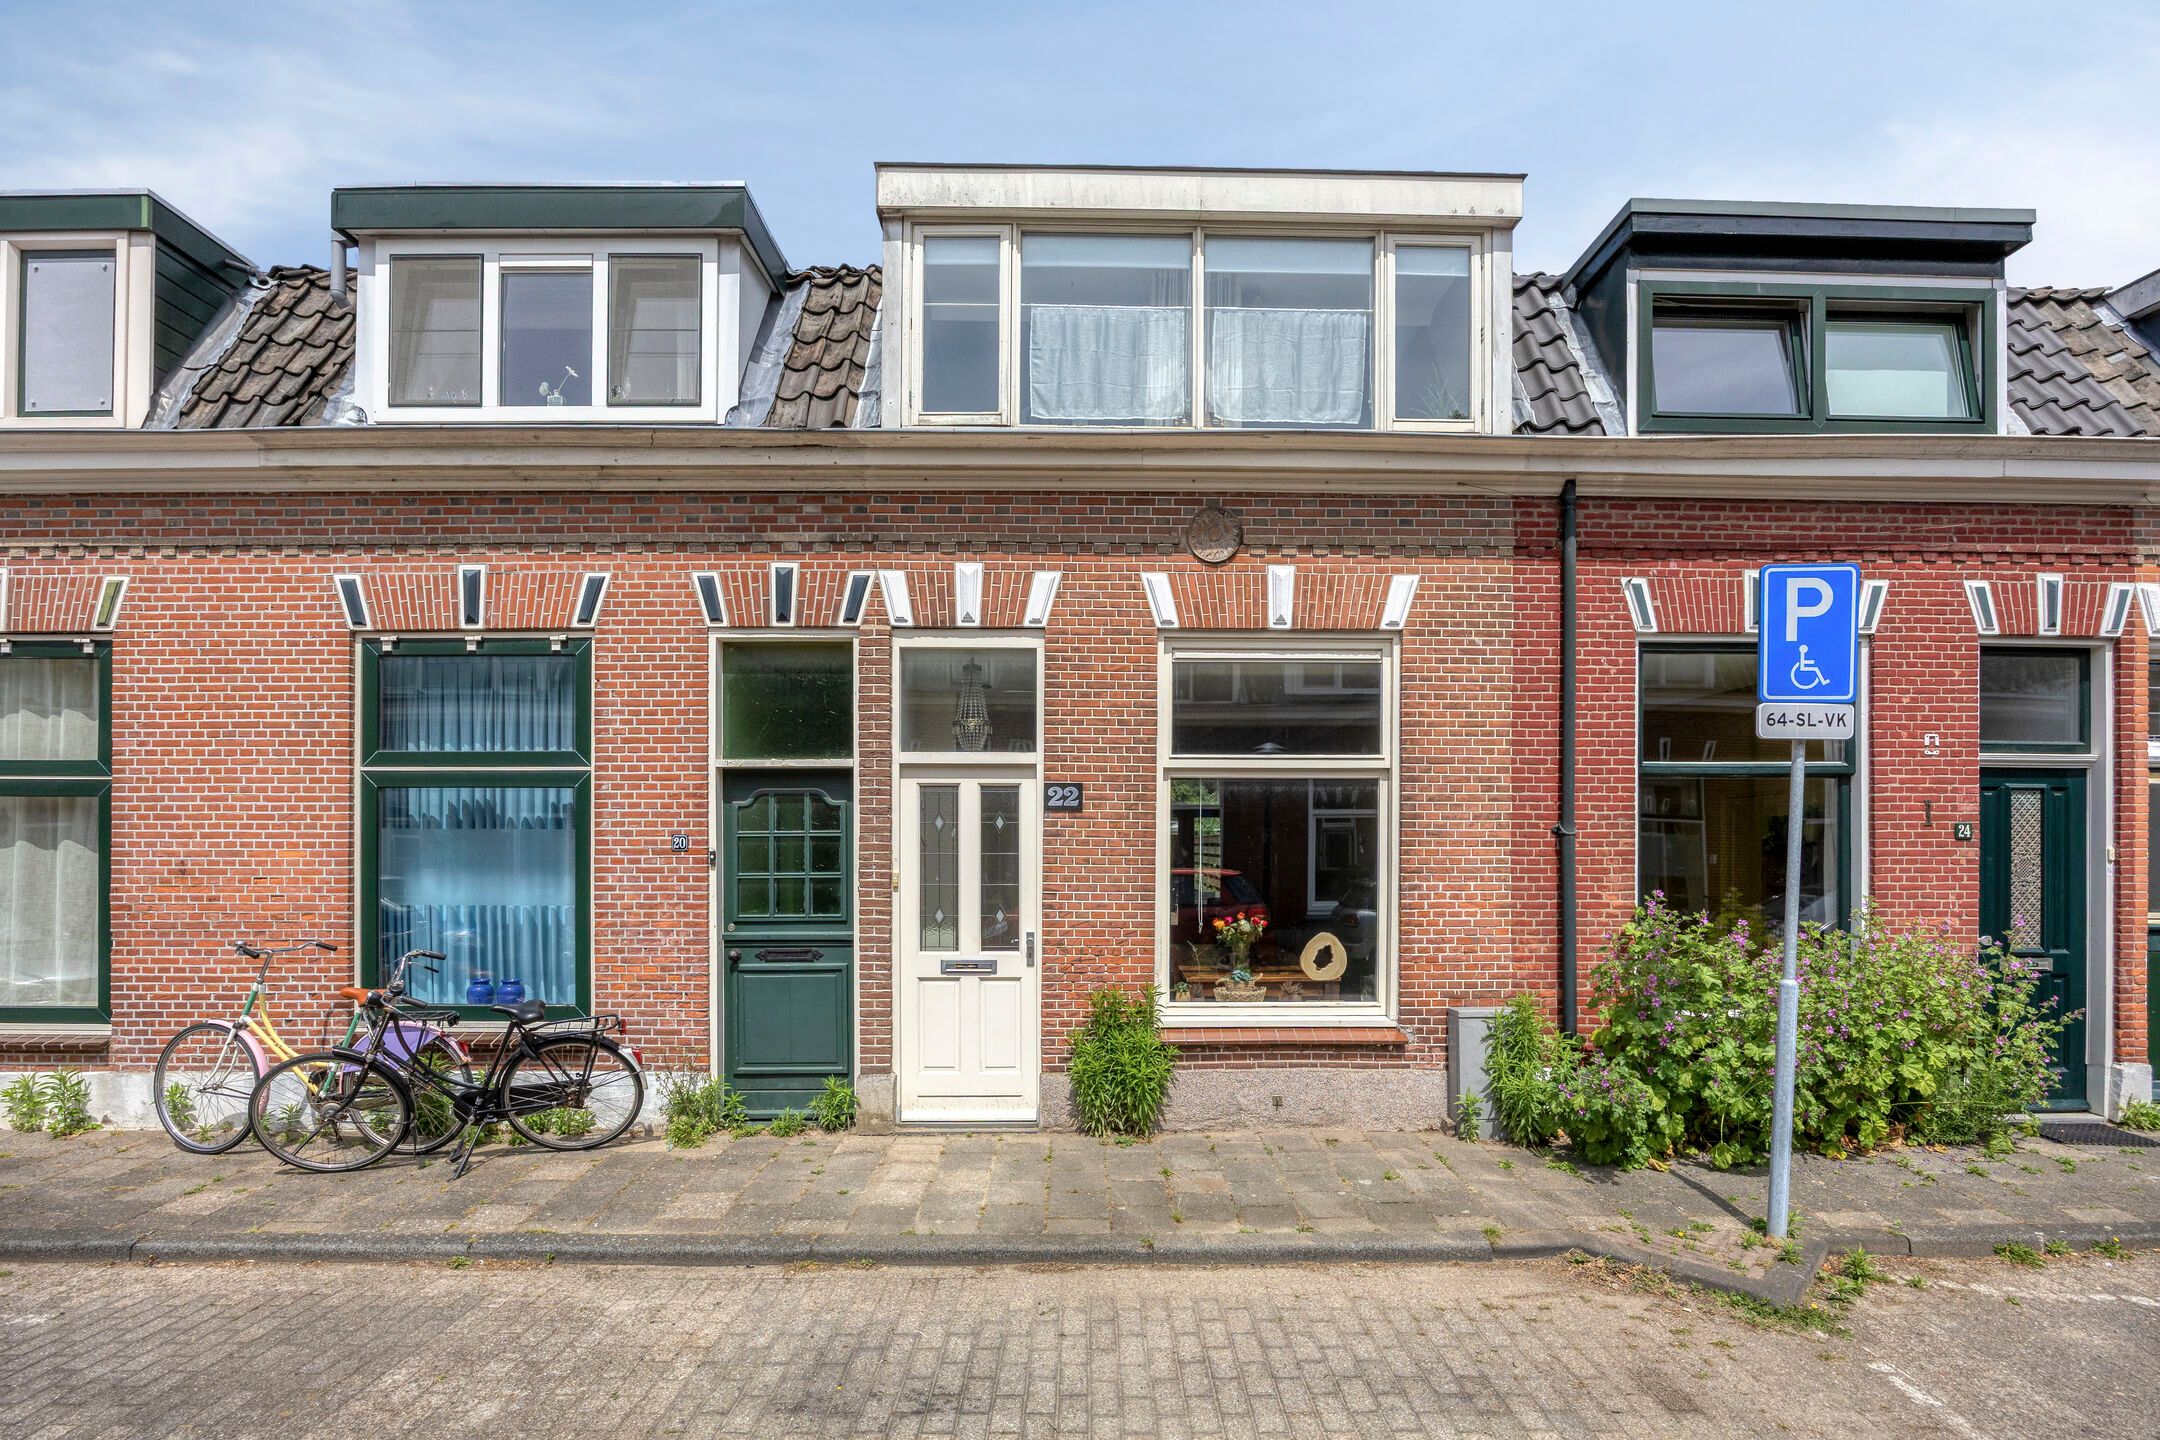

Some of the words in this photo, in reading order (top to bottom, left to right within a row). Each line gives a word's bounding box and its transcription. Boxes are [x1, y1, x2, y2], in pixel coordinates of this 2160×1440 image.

[1786, 577, 1834, 642] P
[1766, 712, 1847, 728] 64-SL-VK
[1047, 786, 1080, 807] 22
[1958, 824, 1971, 838] 24
[673, 837, 686, 849] 20
